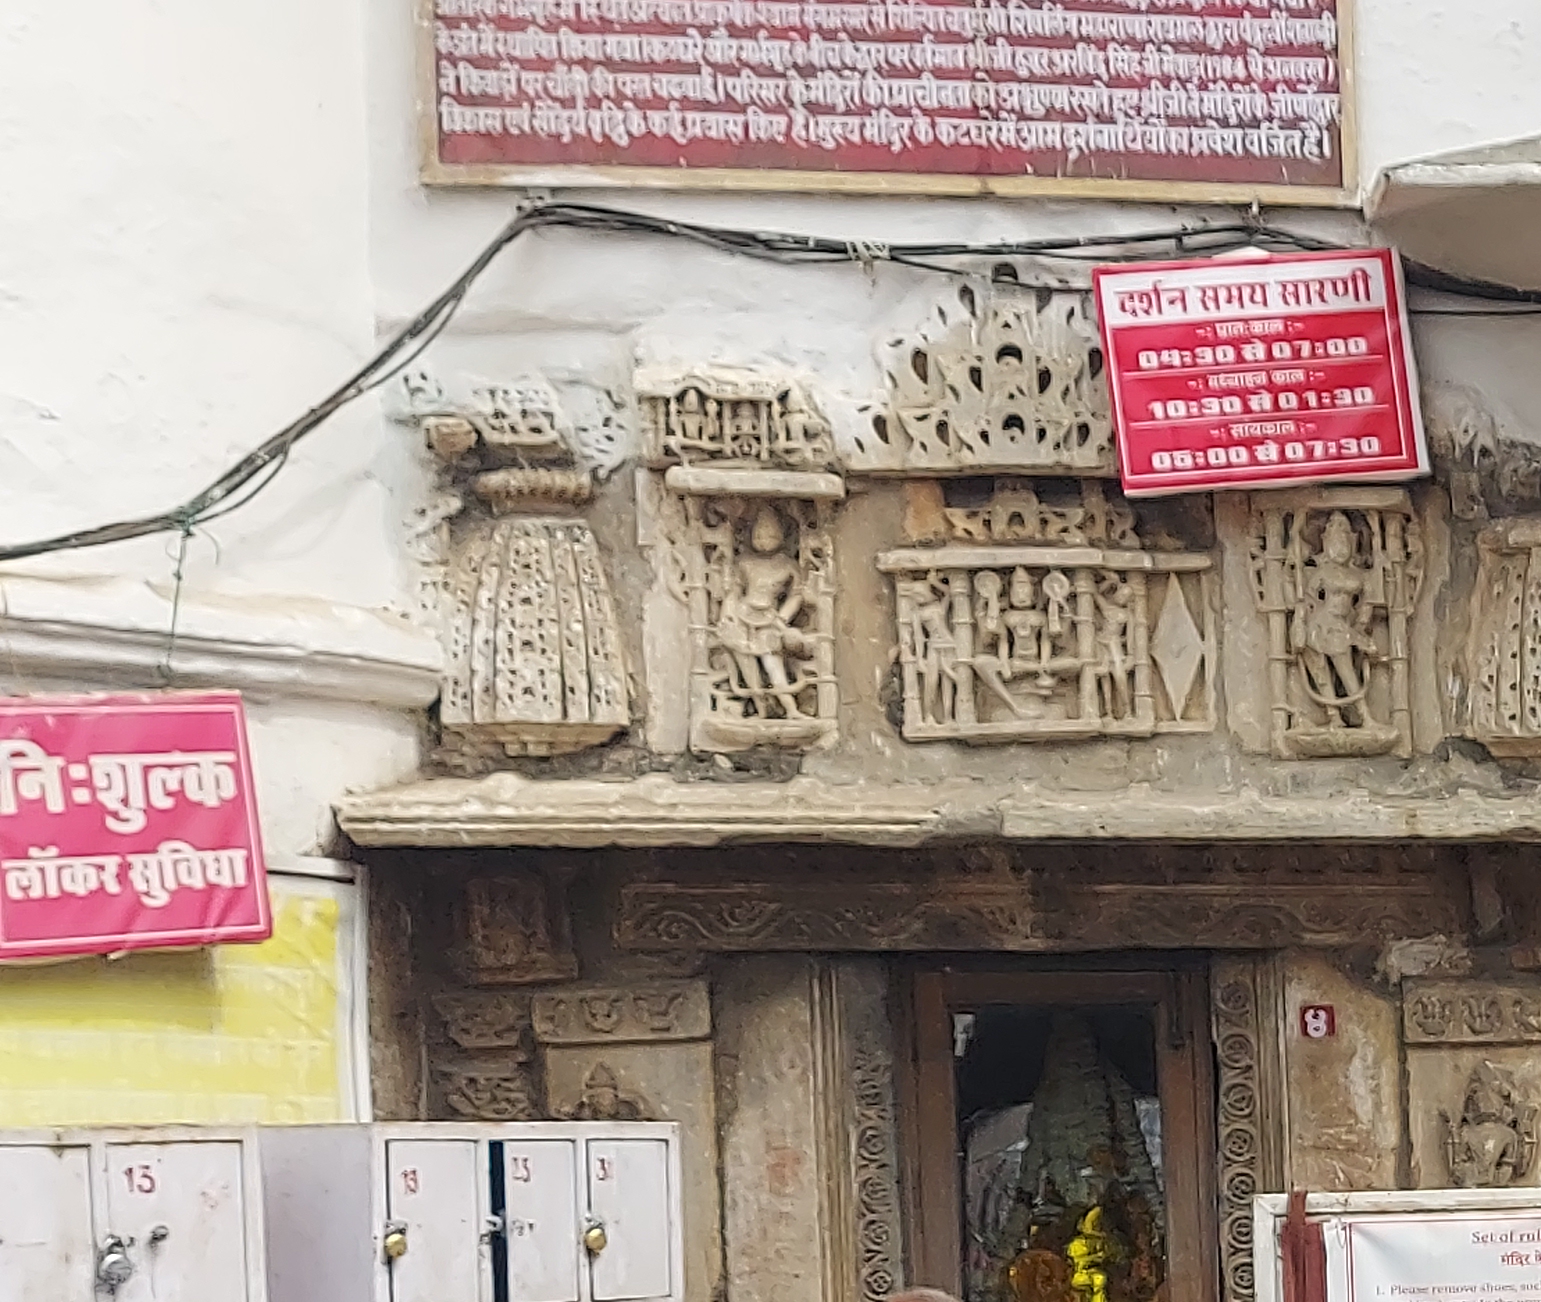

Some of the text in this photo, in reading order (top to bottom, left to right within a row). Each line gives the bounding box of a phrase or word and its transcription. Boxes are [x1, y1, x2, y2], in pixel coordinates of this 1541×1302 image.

[1114, 268, 1371, 317] दर्शन समय सारणी
[1240, 338, 1266, 362] से
[1247, 391, 1272, 414] से
[1254, 440, 1278, 464] से
[1, 840, 247, 908] लॉकर सुविधा
[123, 1165, 156, 1194] 15
[1499, 1229, 1514, 1243] of
